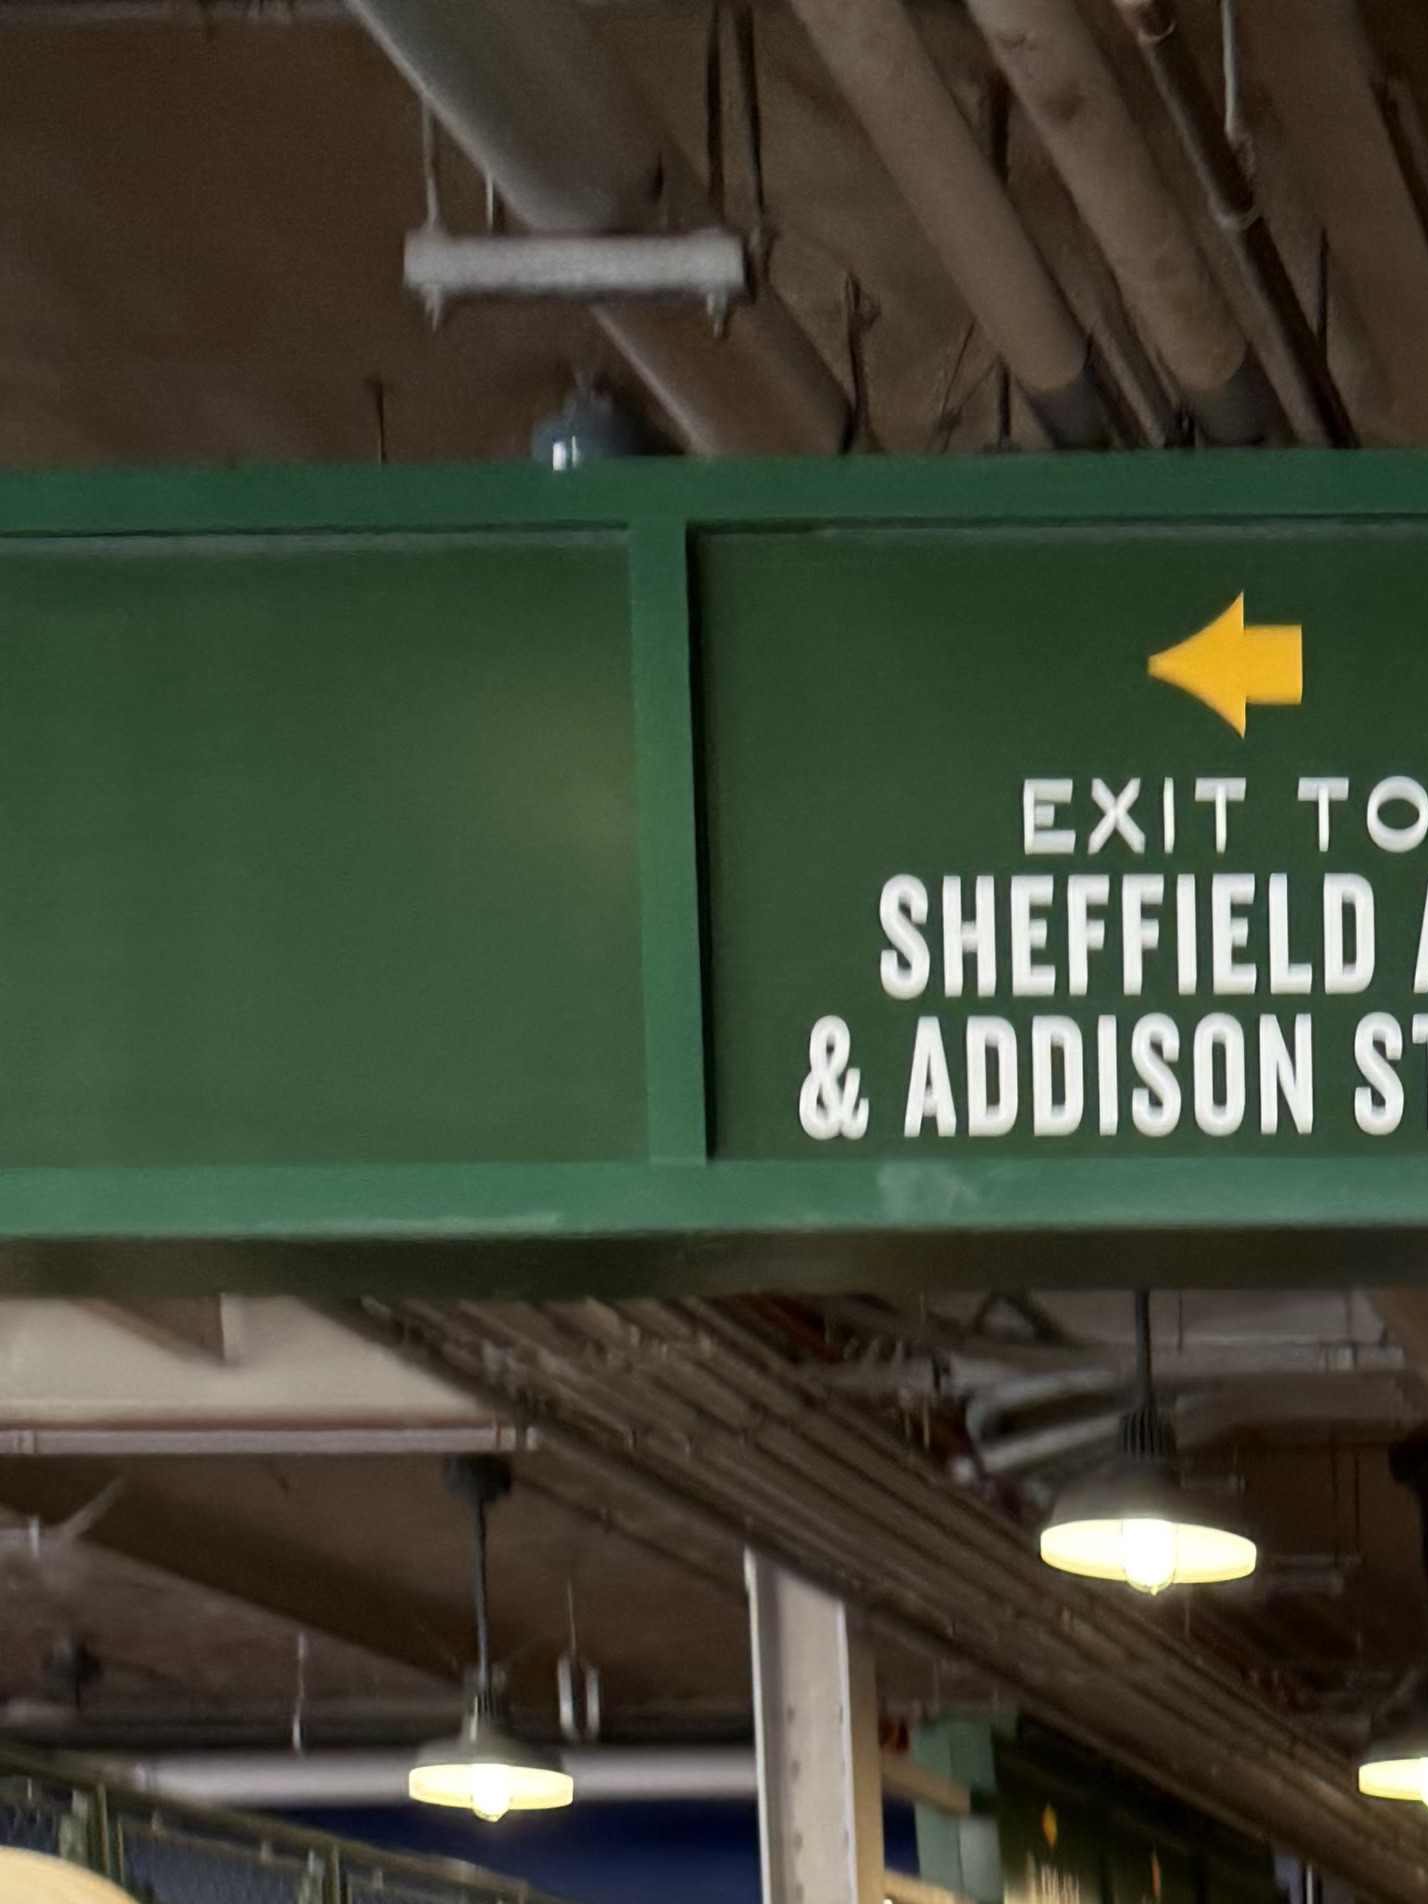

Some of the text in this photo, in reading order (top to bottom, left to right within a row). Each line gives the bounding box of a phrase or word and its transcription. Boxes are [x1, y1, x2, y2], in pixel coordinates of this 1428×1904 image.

[1023, 777, 1246, 854] EXIT
[879, 874, 1376, 998] SHEFFIELD
[798, 1014, 870, 1142] &
[904, 1013, 1314, 1139] ADDISON
